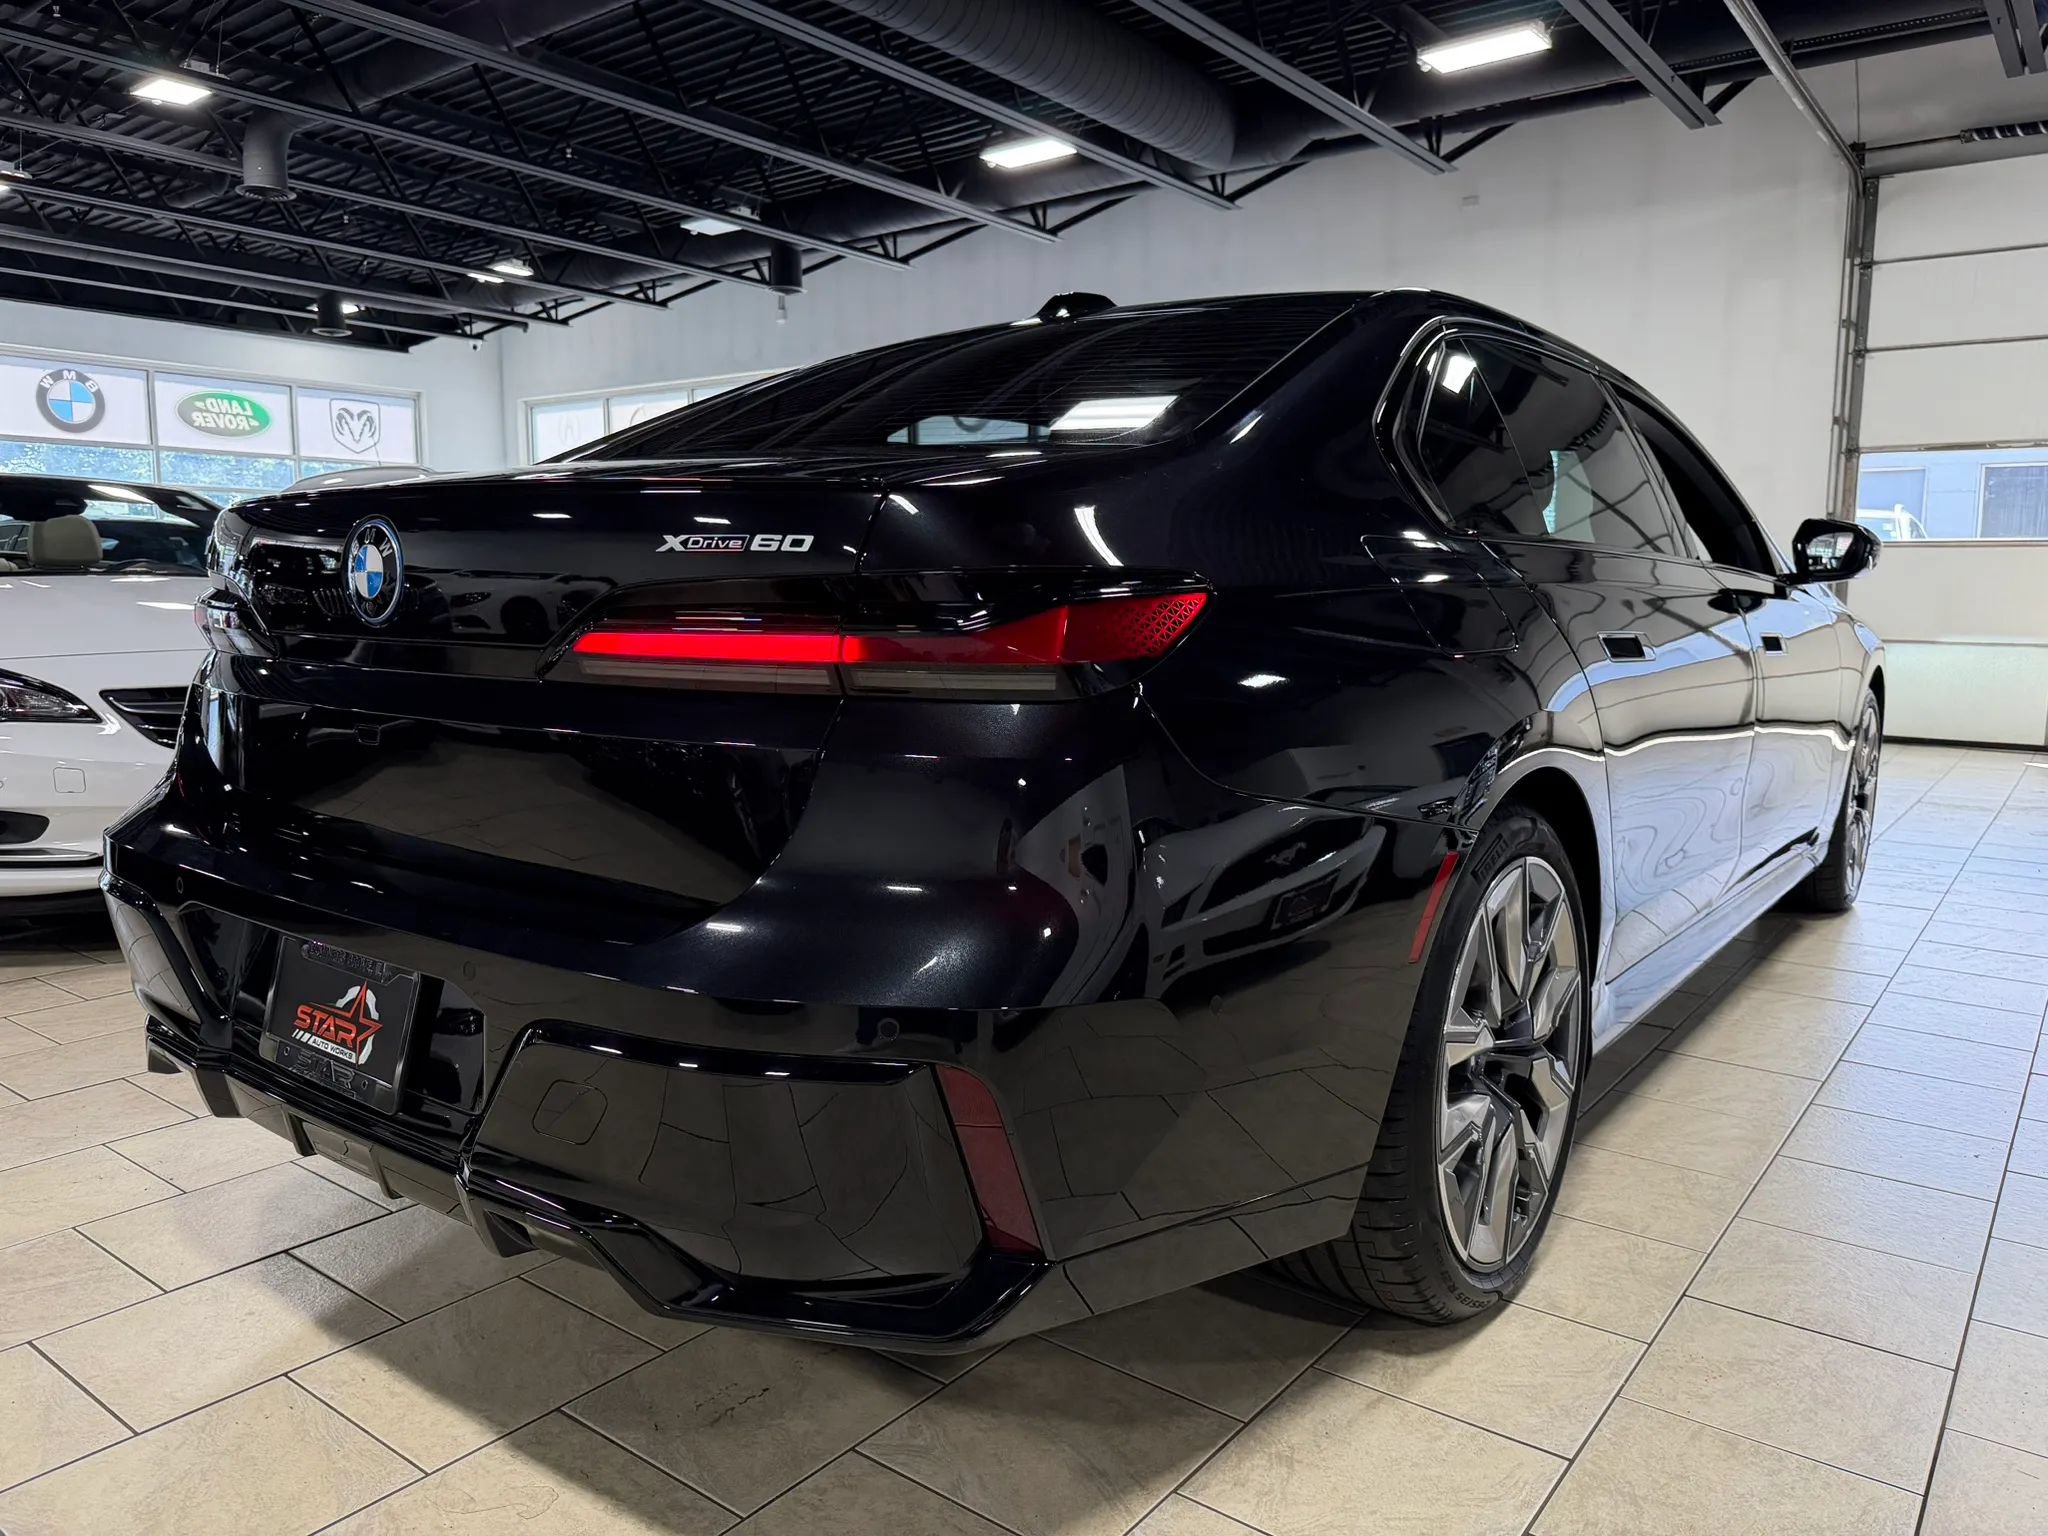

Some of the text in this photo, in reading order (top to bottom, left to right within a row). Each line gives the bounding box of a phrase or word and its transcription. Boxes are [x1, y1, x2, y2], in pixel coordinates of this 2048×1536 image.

[351, 528, 393, 558] BMW
[750, 534, 814, 552] 60
[293, 1004, 357, 1048] STAR
[312, 1037, 354, 1061] AUTO WORKS
